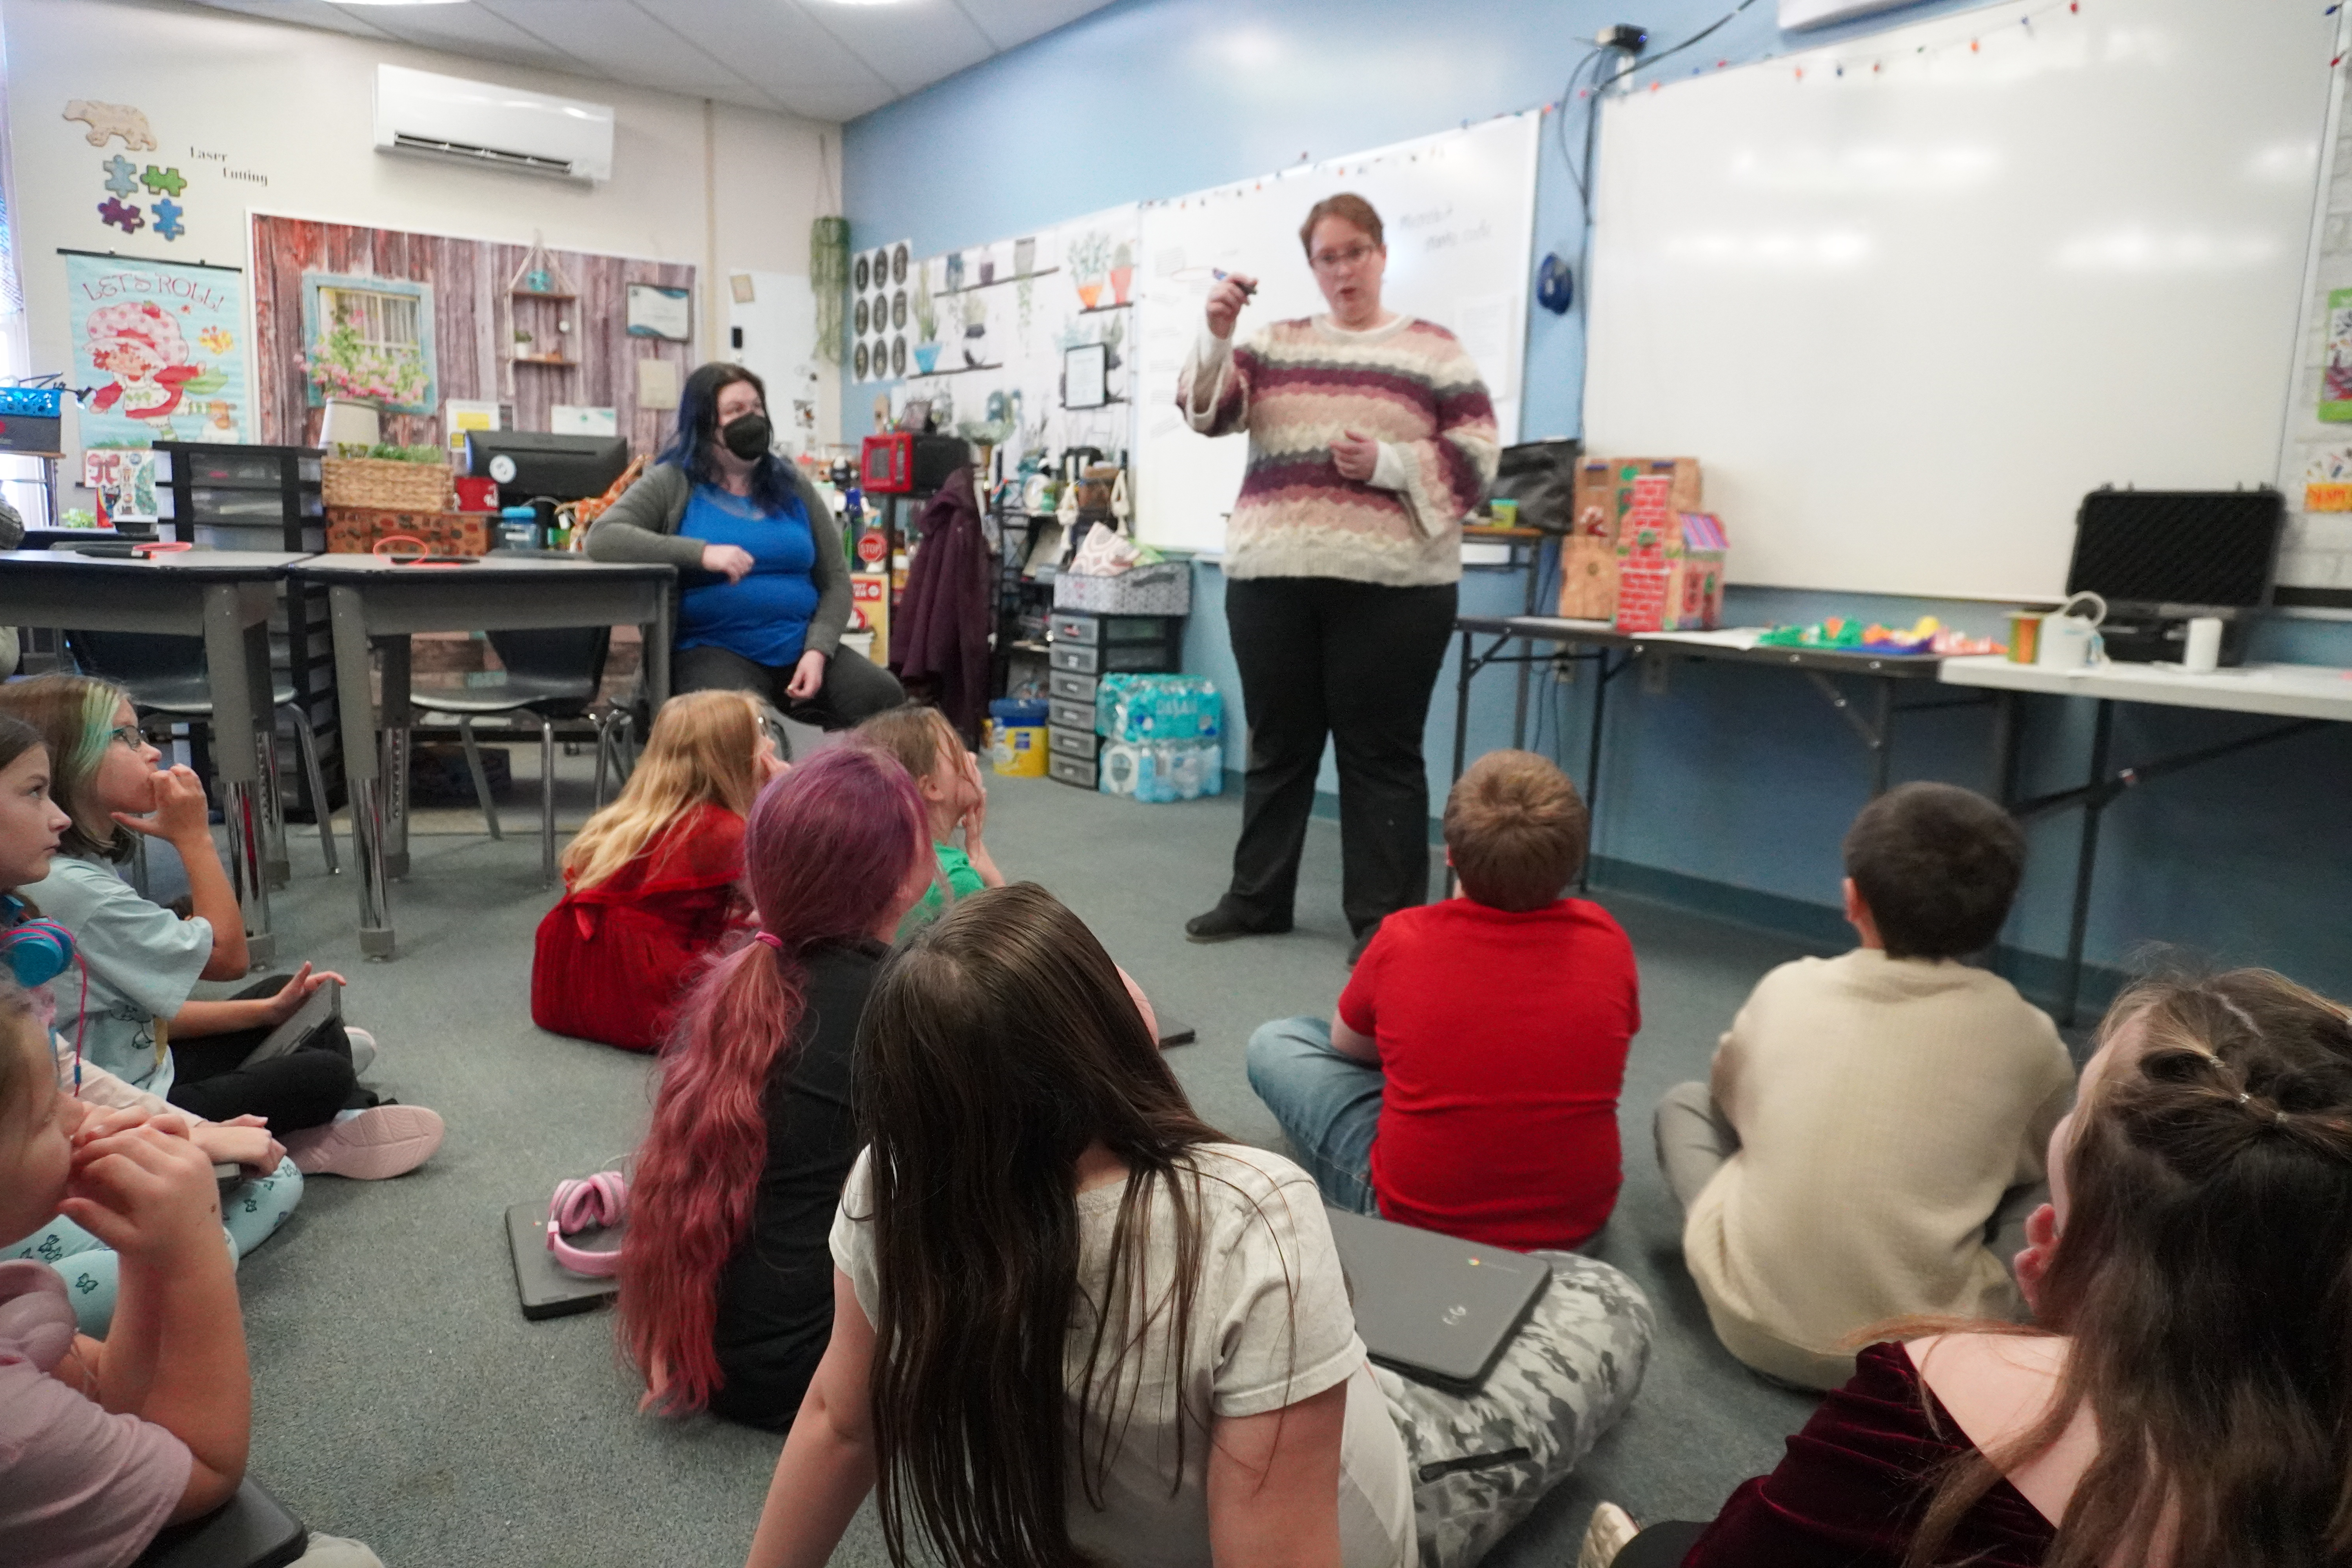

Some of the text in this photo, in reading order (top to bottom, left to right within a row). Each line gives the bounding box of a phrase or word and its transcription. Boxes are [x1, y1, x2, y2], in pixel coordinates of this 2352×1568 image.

[191, 145, 227, 162] Laser
[223, 166, 268, 187] Cutting
[82, 272, 224, 313] LET'S ROLL!
[860, 544, 880, 554] STOP
